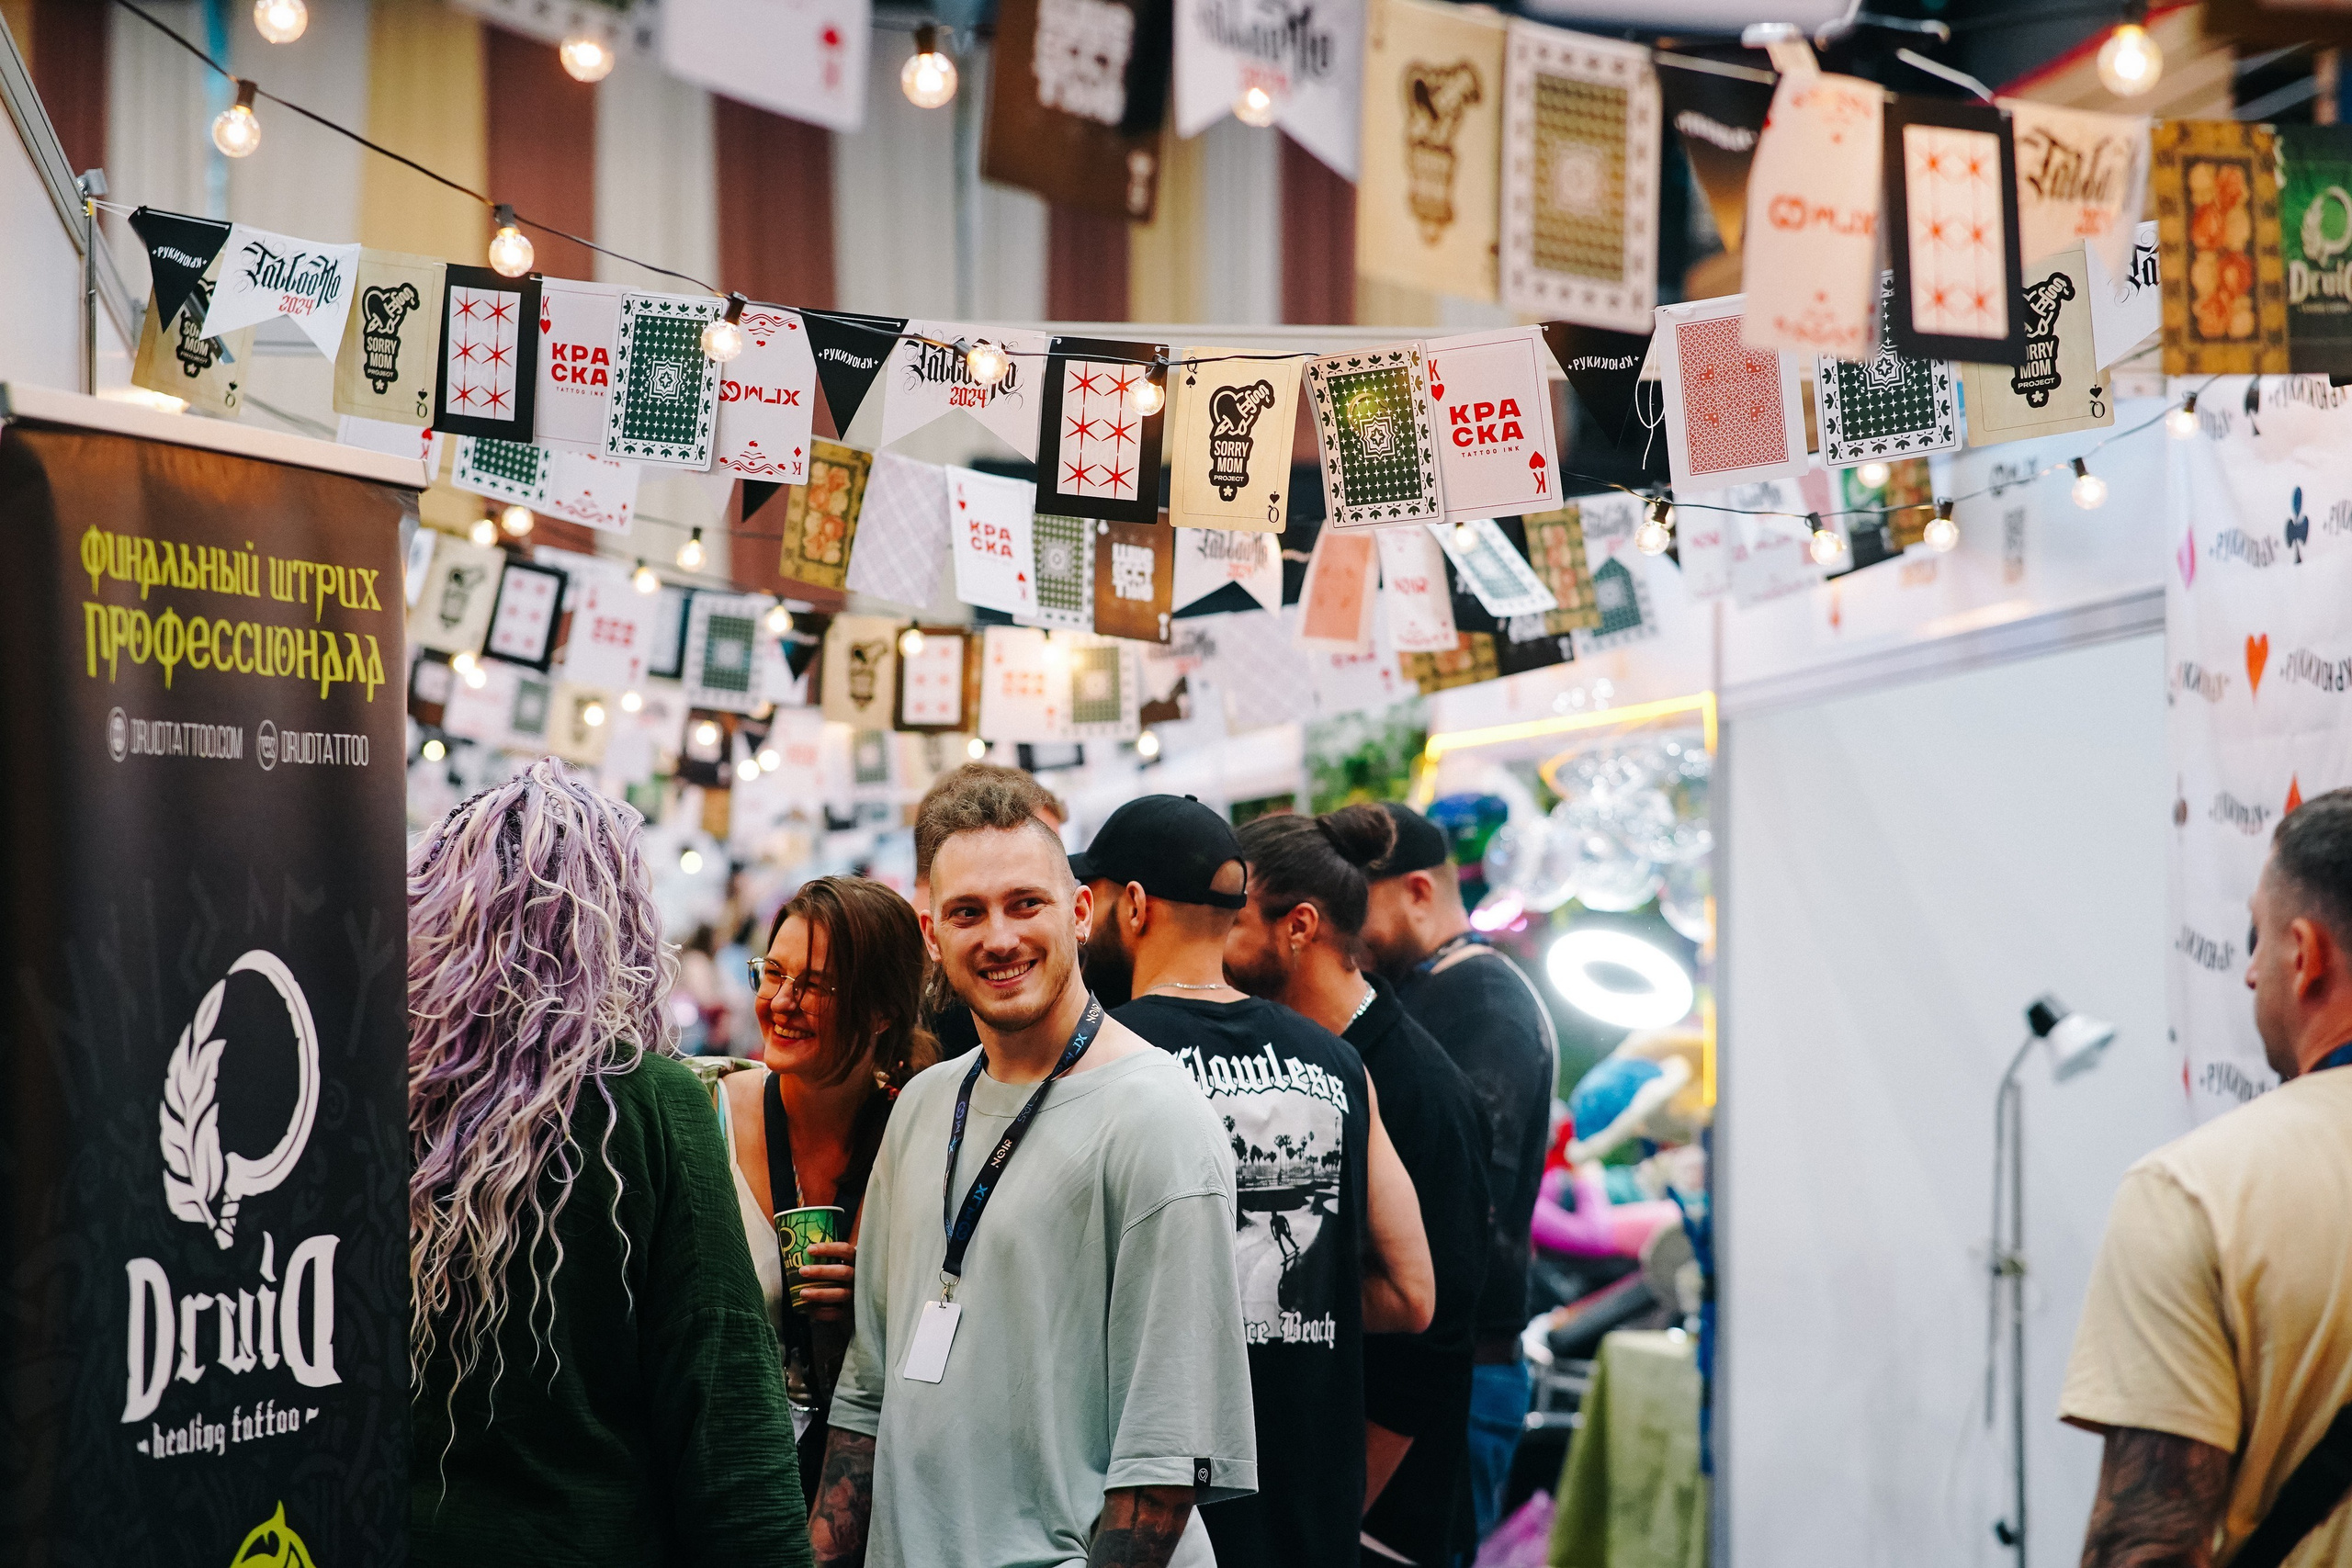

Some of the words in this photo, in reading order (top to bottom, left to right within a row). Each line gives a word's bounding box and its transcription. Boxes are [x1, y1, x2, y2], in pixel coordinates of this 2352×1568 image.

[278, 294, 315, 316] 2024
[185, 337, 209, 356] MOM
[368, 336, 398, 355] SORRY
[551, 342, 610, 366] КРА
[2026, 341, 2054, 360] RRY
[369, 353, 393, 369] MOM
[2020, 359, 2052, 379] MOM
[551, 363, 608, 387] СКА
[2018, 378, 2055, 389] PROJECT
[556, 386, 585, 395] TATTOO
[949, 386, 987, 409] 2024
[1449, 399, 1521, 425] КРА
[1452, 421, 1524, 447] СКА
[1214, 440, 1250, 457] SORRY
[1461, 448, 1498, 458] TATTOO
[1217, 457, 1244, 473] MOM
[281, 730, 368, 766] DRUIDTATTOO
[990, 1138, 1012, 1168] NOIR
[1280, 1311, 1336, 1349] Beach
[153, 1412, 226, 1459] healing
[231, 1399, 300, 1443] tattoo
